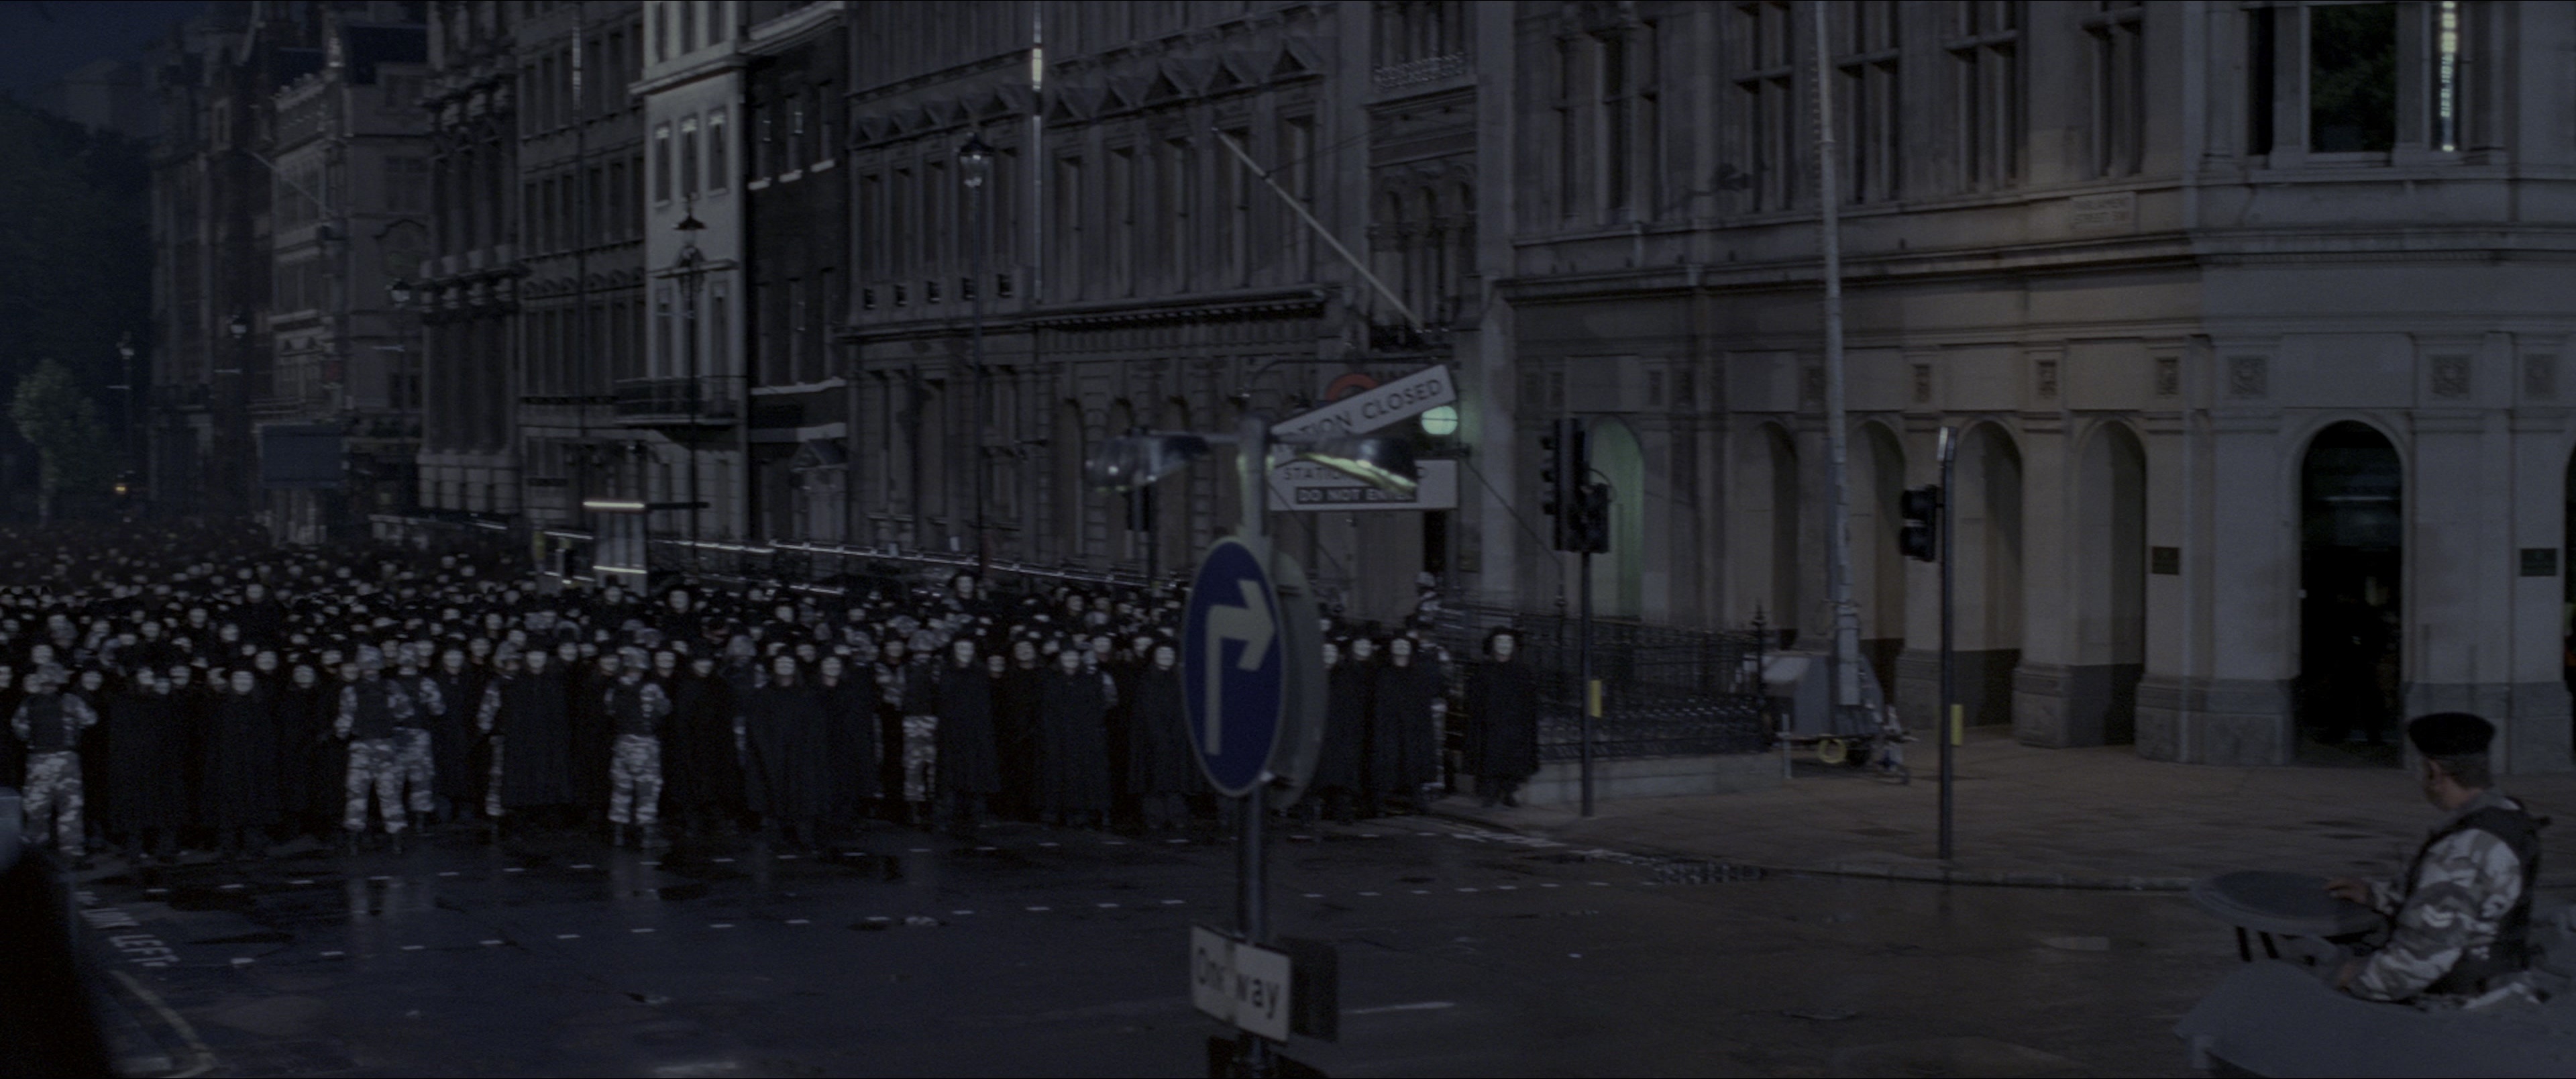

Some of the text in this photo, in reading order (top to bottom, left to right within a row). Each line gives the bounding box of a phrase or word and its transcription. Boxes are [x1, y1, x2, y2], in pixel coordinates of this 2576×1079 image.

[1362, 378, 1441, 419] CLOSED
[1299, 489, 1322, 501] DO
[1326, 489, 1362, 501] NOT
[109, 933, 181, 964] LEFT
[1236, 973, 1281, 1019] way
